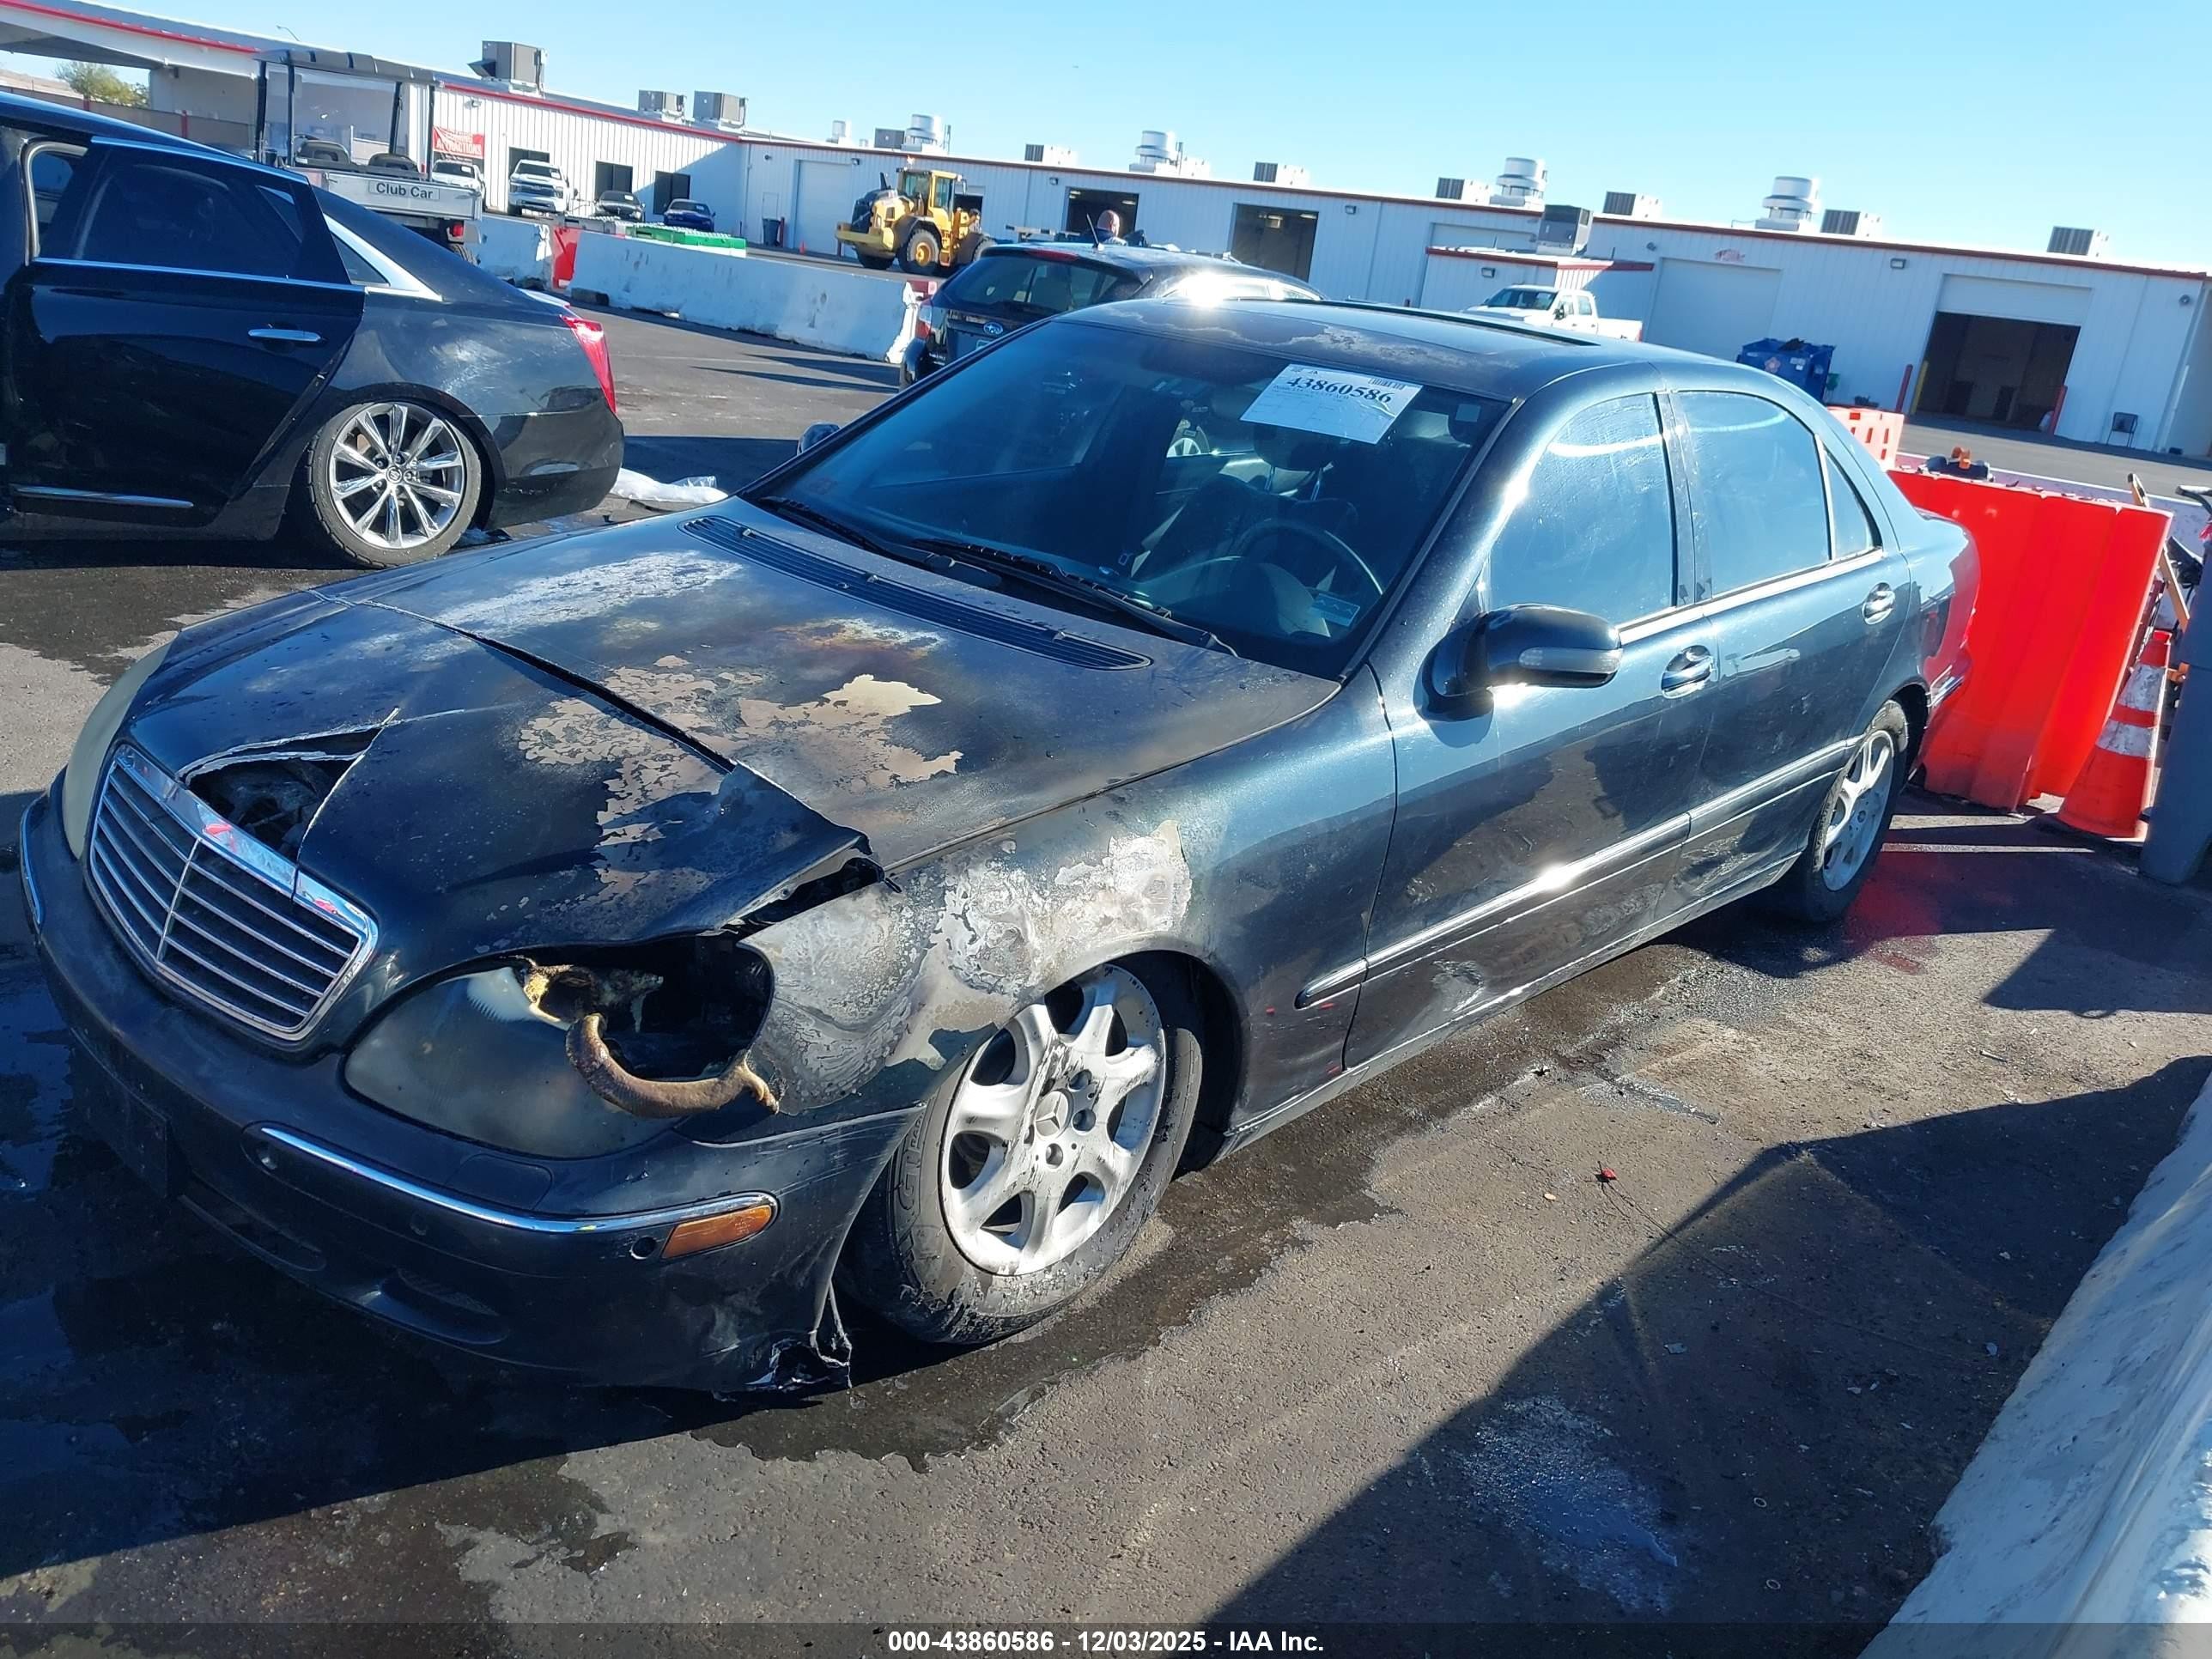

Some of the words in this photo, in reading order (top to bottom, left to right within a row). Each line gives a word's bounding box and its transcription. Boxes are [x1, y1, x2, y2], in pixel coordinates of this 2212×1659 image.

[376, 182, 407, 196] Club
[410, 186, 434, 198] Car
[1286, 375, 1395, 404] 43860586
